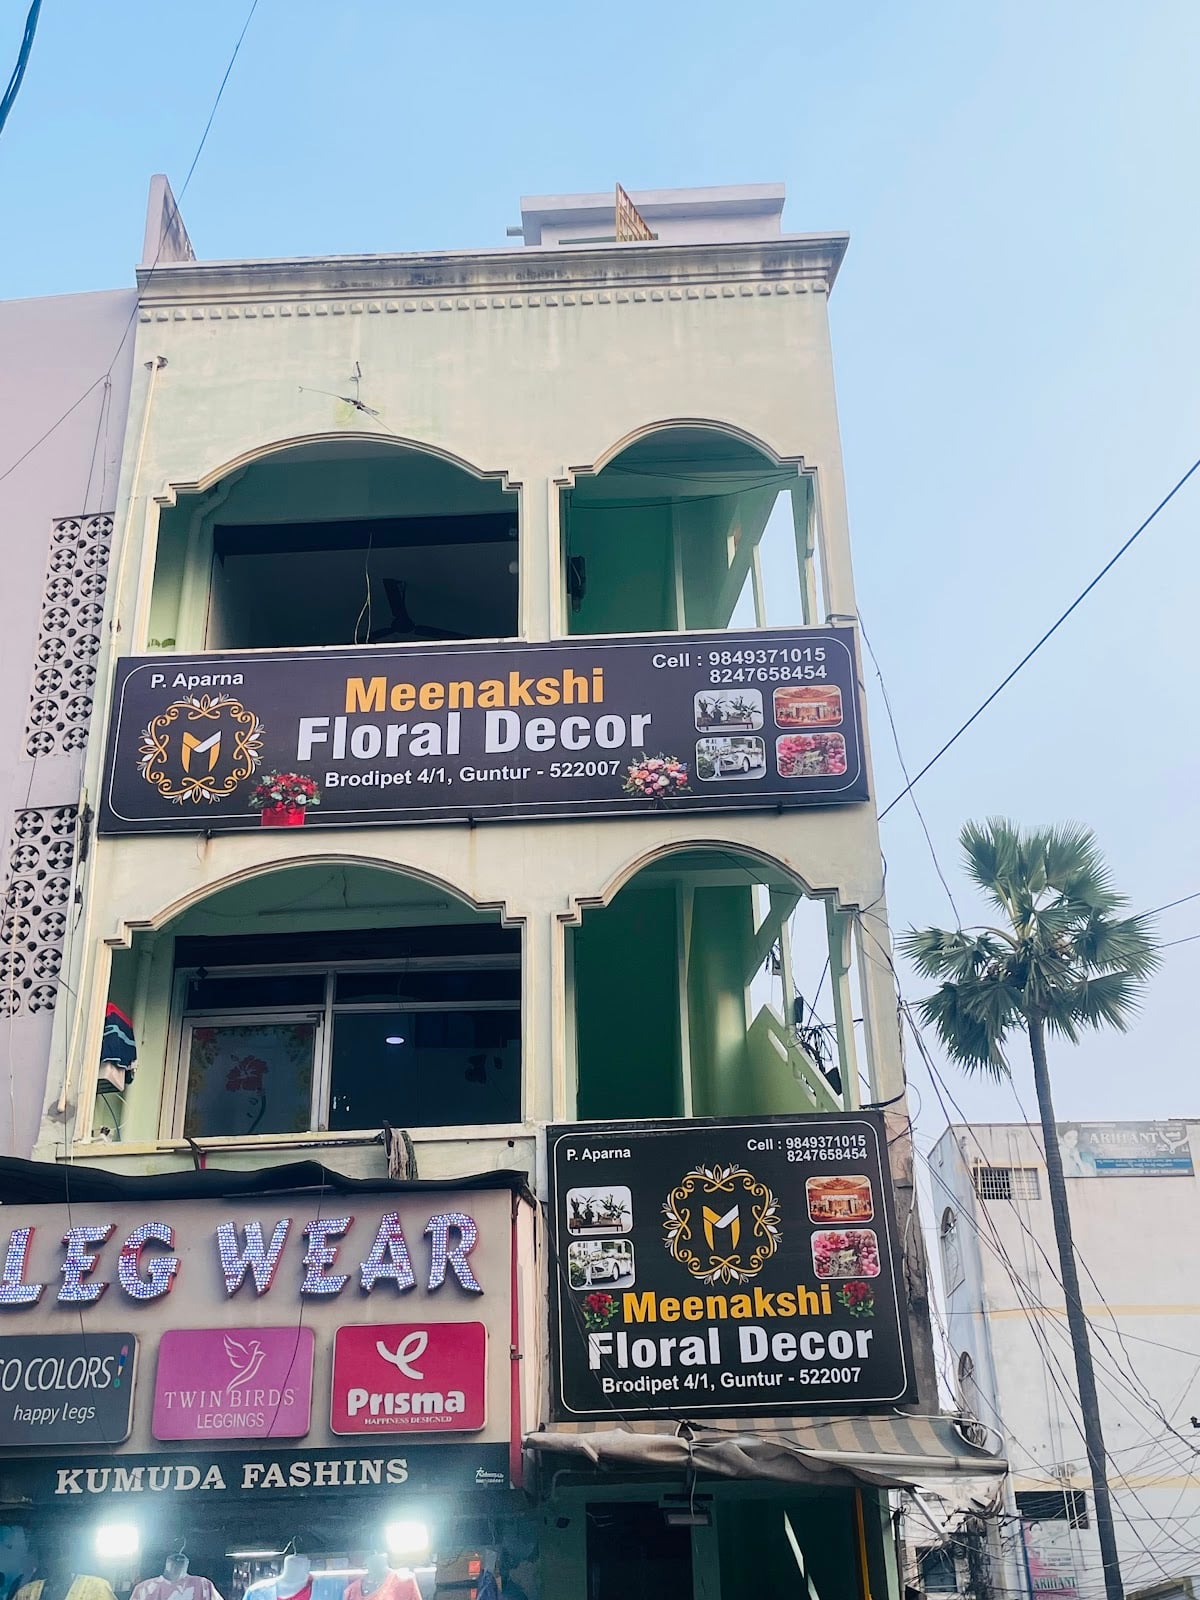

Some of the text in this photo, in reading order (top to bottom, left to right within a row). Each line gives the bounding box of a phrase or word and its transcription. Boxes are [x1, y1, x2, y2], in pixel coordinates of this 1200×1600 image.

[652, 653, 691, 669] Cell
[709, 648, 826, 666] 9849371015
[151, 672, 244, 690] P. Aparna
[710, 665, 827, 683] 8247658454
[345, 668, 604, 713] Meenakshi
[297, 709, 652, 761] Floral Decor
[325, 769, 412, 789] Brodipet
[416, 767, 453, 785] 4/1,
[459, 764, 531, 782] Guntur
[550, 760, 620, 778] 522007
[567, 1147, 631, 1163] P. Aparna
[747, 1139, 773, 1151] Cell
[786, 1135, 866, 1149] 9849371015
[787, 1148, 867, 1162] 8247658454
[0, 1212, 484, 1304] LEG WEAR
[622, 1284, 832, 1324] Meenakshi
[588, 1326, 873, 1370] Floral Decor
[0, 1359, 22, 1391] O
[602, 1375, 679, 1395] Brodipet
[683, 1372, 715, 1391] 4/1,
[720, 1371, 783, 1389] Guntur
[800, 1367, 861, 1384] 522007
[164, 1388, 295, 1409] TWIN BIRDS
[348, 1388, 465, 1416] Prisma
[13, 1402, 96, 1425] happy legs
[197, 1412, 265, 1429] LEGGINGS
[55, 1458, 409, 1494] KUMUDA FASHINS
